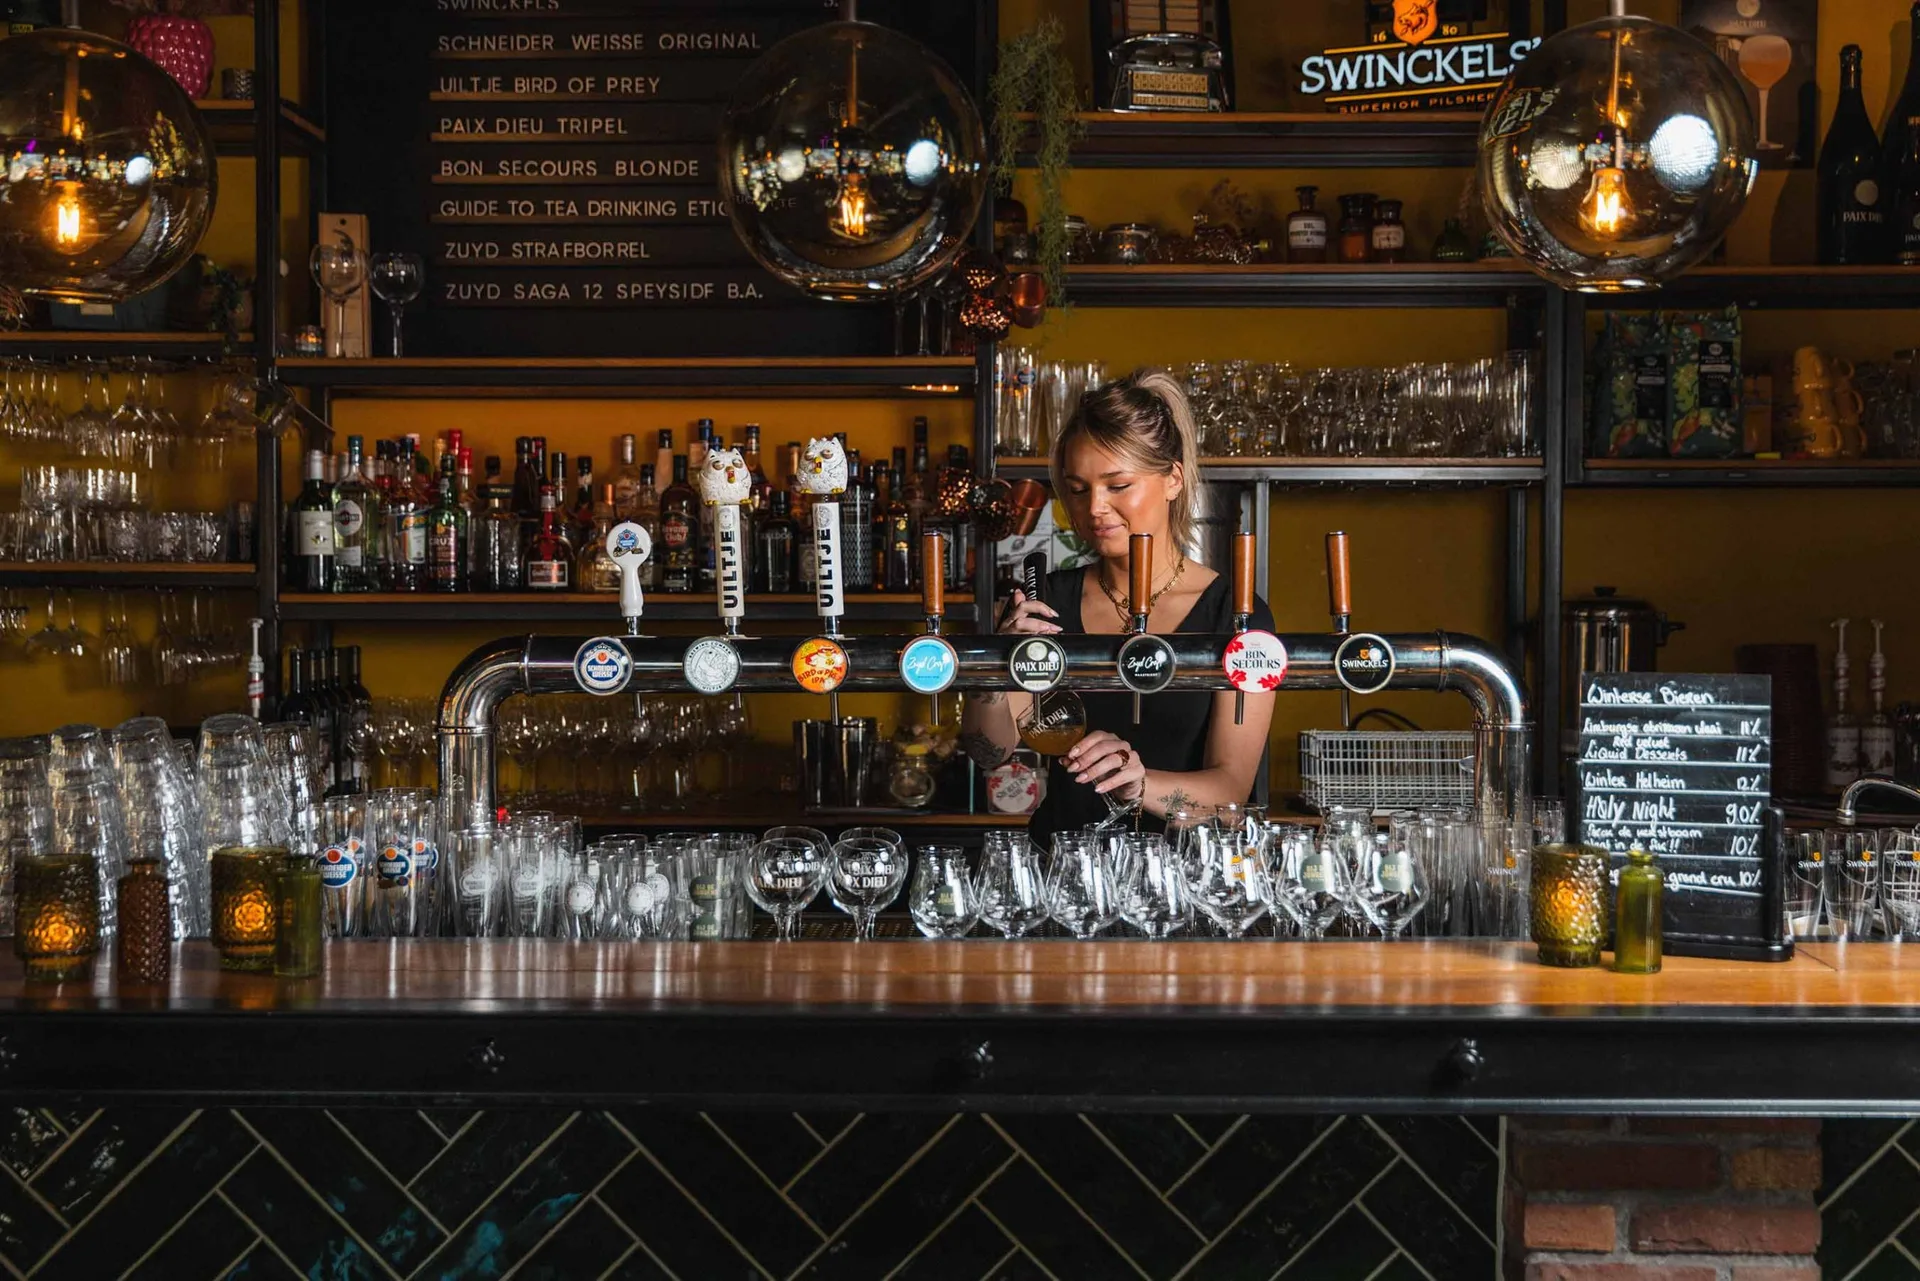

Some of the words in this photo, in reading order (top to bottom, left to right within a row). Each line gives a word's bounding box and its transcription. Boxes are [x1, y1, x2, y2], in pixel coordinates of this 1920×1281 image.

[1373, 31, 1387, 43] 16
[1442, 25, 1458, 36] 80
[438, 35, 555, 51] SCHNEIDER
[571, 34, 644, 50] WEISSE
[658, 33, 761, 50] ORIGINAL
[514, 77, 558, 93] BIRD
[567, 77, 596, 93] OF
[606, 77, 661, 93] PREY
[1339, 100, 1420, 114] SUPERIOR
[440, 118, 486, 134] PAIX
[496, 118, 544, 134] DIEU
[557, 118, 628, 134] TRIPEL
[441, 160, 484, 176] BON
[499, 160, 598, 176] SECOURS
[615, 160, 699, 176] BLONDE
[440, 200, 499, 216] GUIDE
[507, 200, 535, 216] TO
[544, 200, 579, 216] TEA
[588, 200, 677, 216] DRINKING
[446, 242, 500, 258] ZUYD
[512, 242, 650, 258] STRAFBORREL
[446, 283, 501, 299] ZUYD
[513, 283, 571, 299] SAGA
[583, 283, 603, 299] 12
[727, 283, 764, 299] B.A.
[720, 530, 739, 609] UILTJE
[817, 528, 834, 608] UILTJE
[1245, 650, 1267, 659] BON
[1015, 661, 1037, 672] PAIX
[1038, 661, 1060, 672] DIEU
[1231, 658, 1281, 670] SECOURS
[797, 669, 817, 683] BIRD
[1028, 720, 1049, 740] PAIX
[1047, 705, 1068, 727] DIEU
[1740, 717, 1762, 736] 11%
[1736, 743, 1762, 763] 11%
[1632, 795, 1678, 831] Night
[1730, 833, 1759, 857] 10%
[777, 876, 802, 889] DIEU
[862, 876, 887, 889] DIEU
